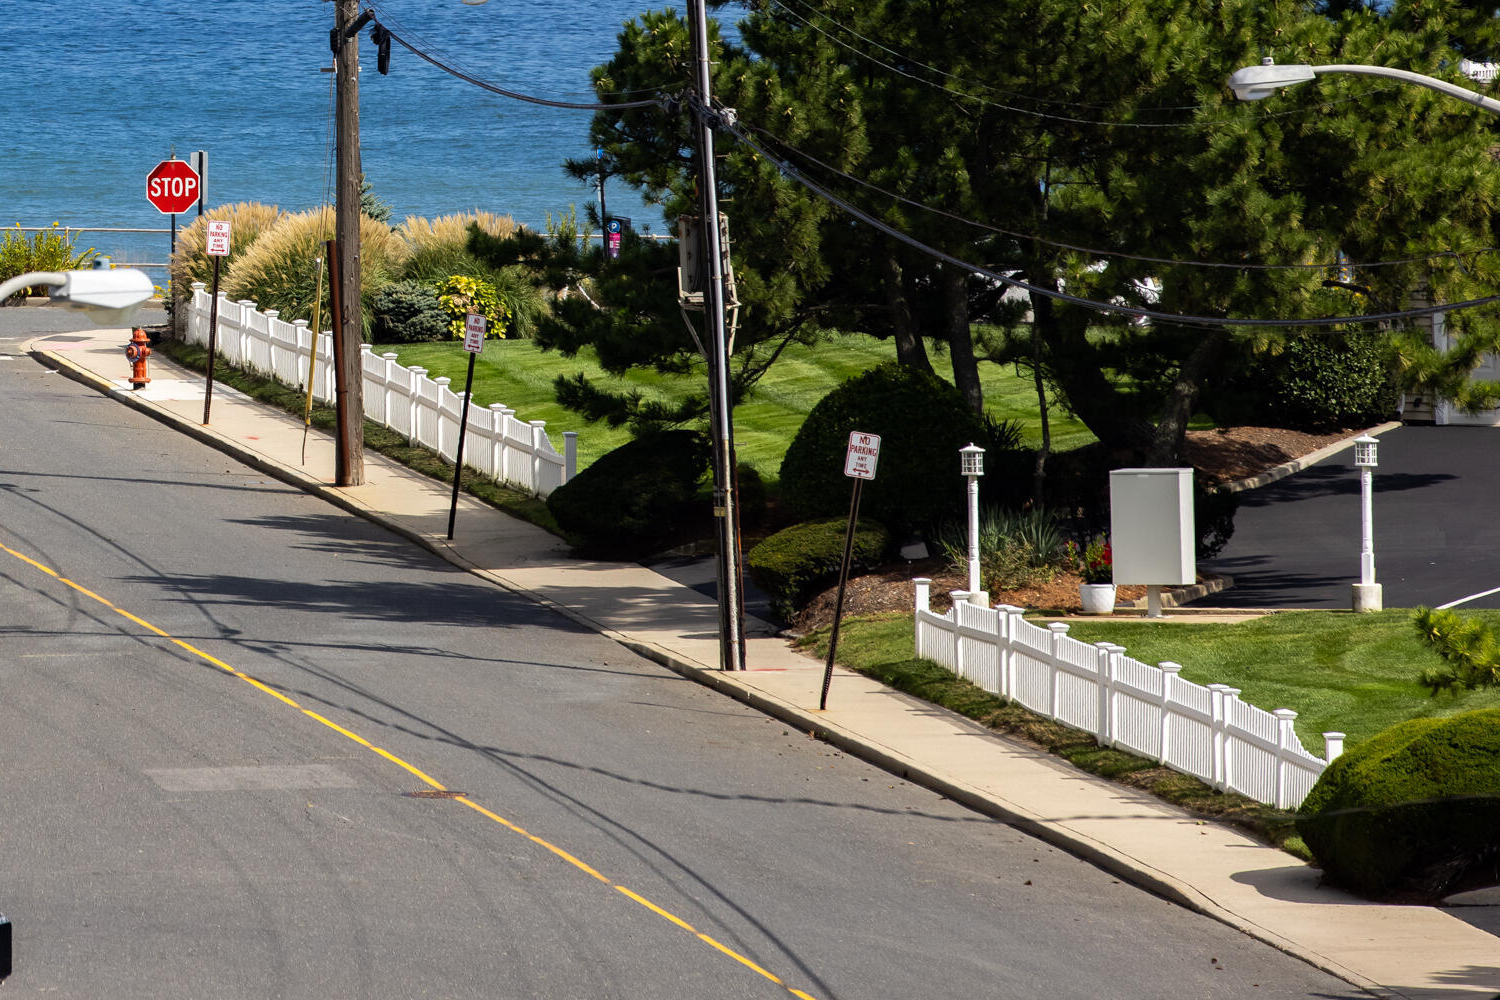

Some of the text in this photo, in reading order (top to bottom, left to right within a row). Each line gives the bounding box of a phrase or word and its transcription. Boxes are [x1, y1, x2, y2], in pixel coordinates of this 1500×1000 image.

[150, 177, 196, 197] STOP
[468, 325, 484, 333] PARKING
[859, 436, 870, 445] NO
[850, 445, 877, 456] PARKING
